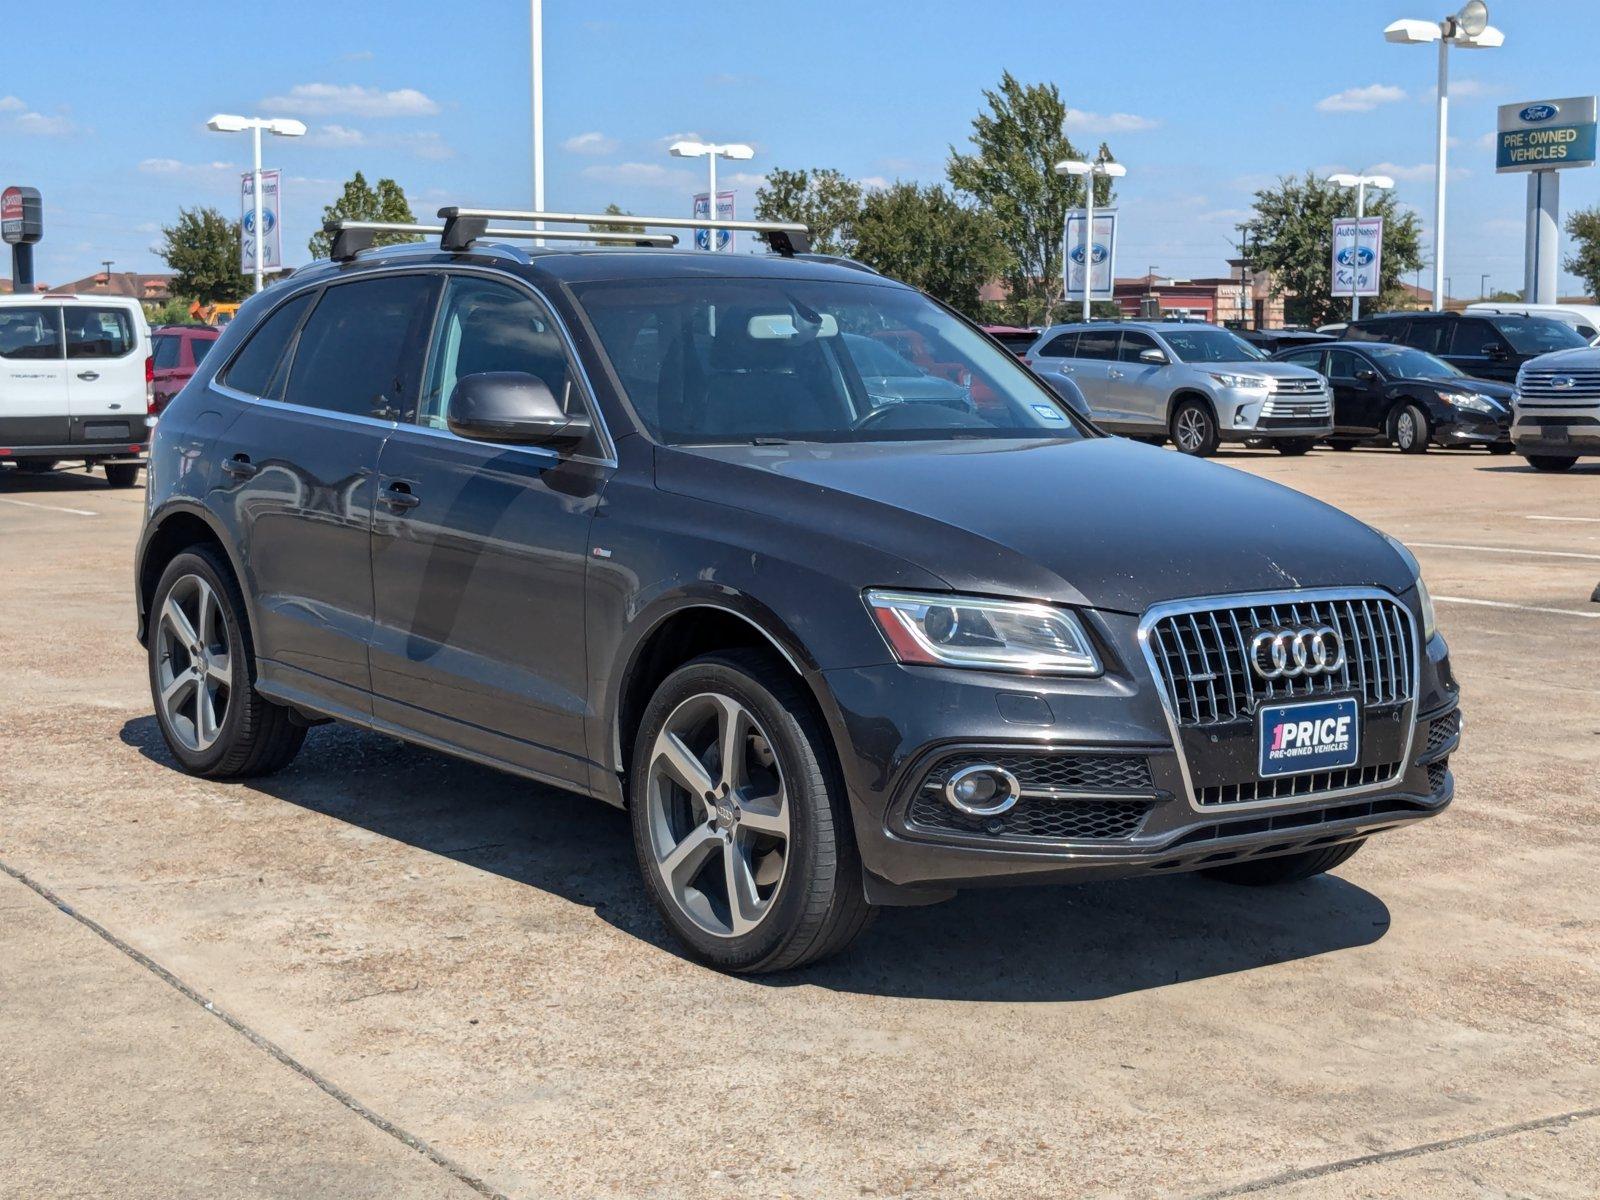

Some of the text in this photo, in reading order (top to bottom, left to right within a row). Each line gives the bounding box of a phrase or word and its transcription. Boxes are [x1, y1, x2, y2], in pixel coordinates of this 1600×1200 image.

[1525, 106, 1549, 120] Ford
[1503, 128, 1577, 148] PRE-OWNED
[1510, 145, 1567, 162] VEHICLES
[1271, 715, 1351, 750] 1PRICE
[1269, 741, 1349, 760] PRE-OWNED VEHICLES
